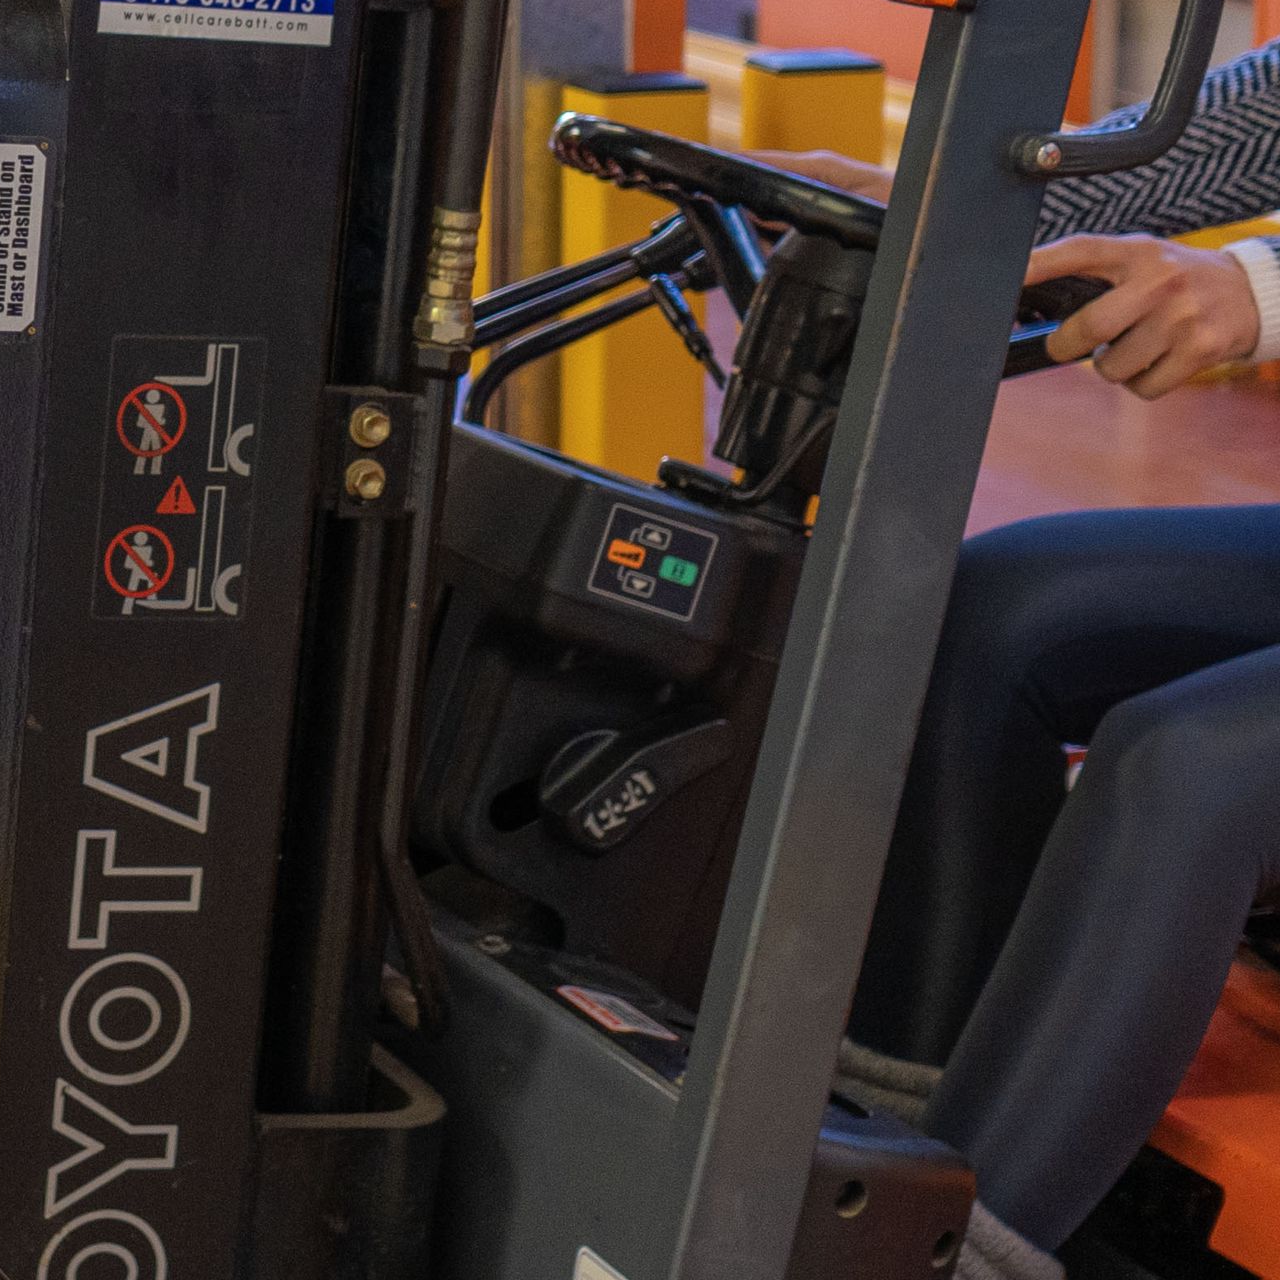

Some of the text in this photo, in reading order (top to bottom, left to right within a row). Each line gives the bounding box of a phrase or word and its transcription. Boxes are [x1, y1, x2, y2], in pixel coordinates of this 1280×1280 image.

[123, 10, 309, 32] www.cellcarebatt.com
[1, 161, 15, 182] on
[6, 154, 35, 317] Mast or Dashboard
